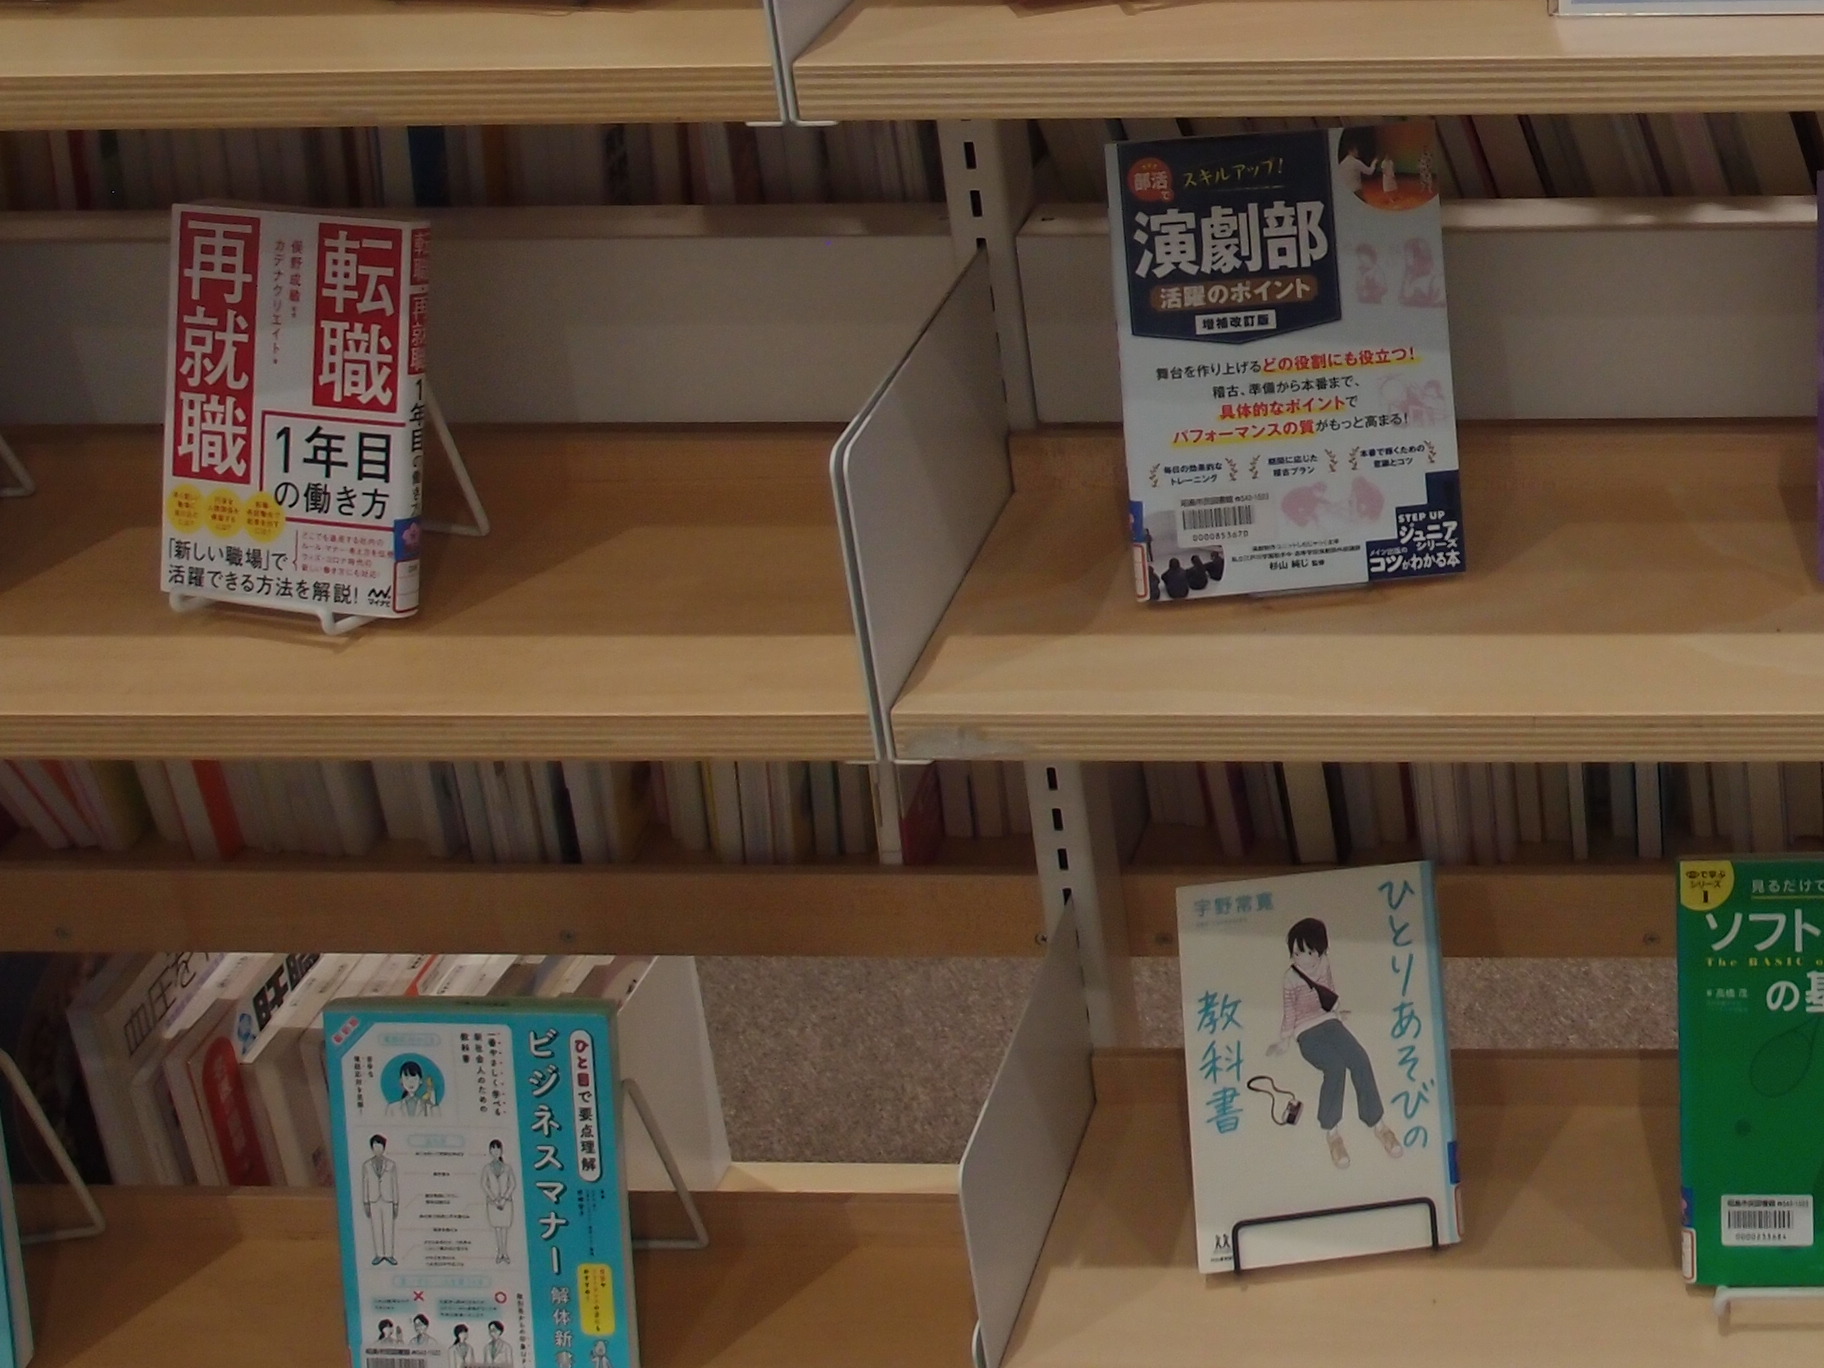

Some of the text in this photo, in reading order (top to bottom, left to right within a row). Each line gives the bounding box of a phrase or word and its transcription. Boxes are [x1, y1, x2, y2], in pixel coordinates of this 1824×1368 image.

[1132, 199, 1329, 280] 演劇部
[1159, 277, 1311, 310] 活躍のポイント
[318, 229, 395, 408] 転職
[177, 219, 253, 478] 再就職
[1219, 394, 1358, 421] 具体的なポイントで
[275, 425, 392, 484] 1年目
[274, 480, 390, 520] の働き方
[1398, 512, 1427, 523] STEP
[1399, 520, 1459, 544] ジュニア
[1414, 538, 1459, 552] シリーズ
[168, 537, 289, 572] 「新しい職場」で
[167, 564, 359, 605] 活躍できる方法を解説！
[1377, 878, 1435, 1150] ひとりあそびの
[1196, 990, 1246, 1136] 教科書
[528, 1028, 570, 1277] ビジネスマナー
